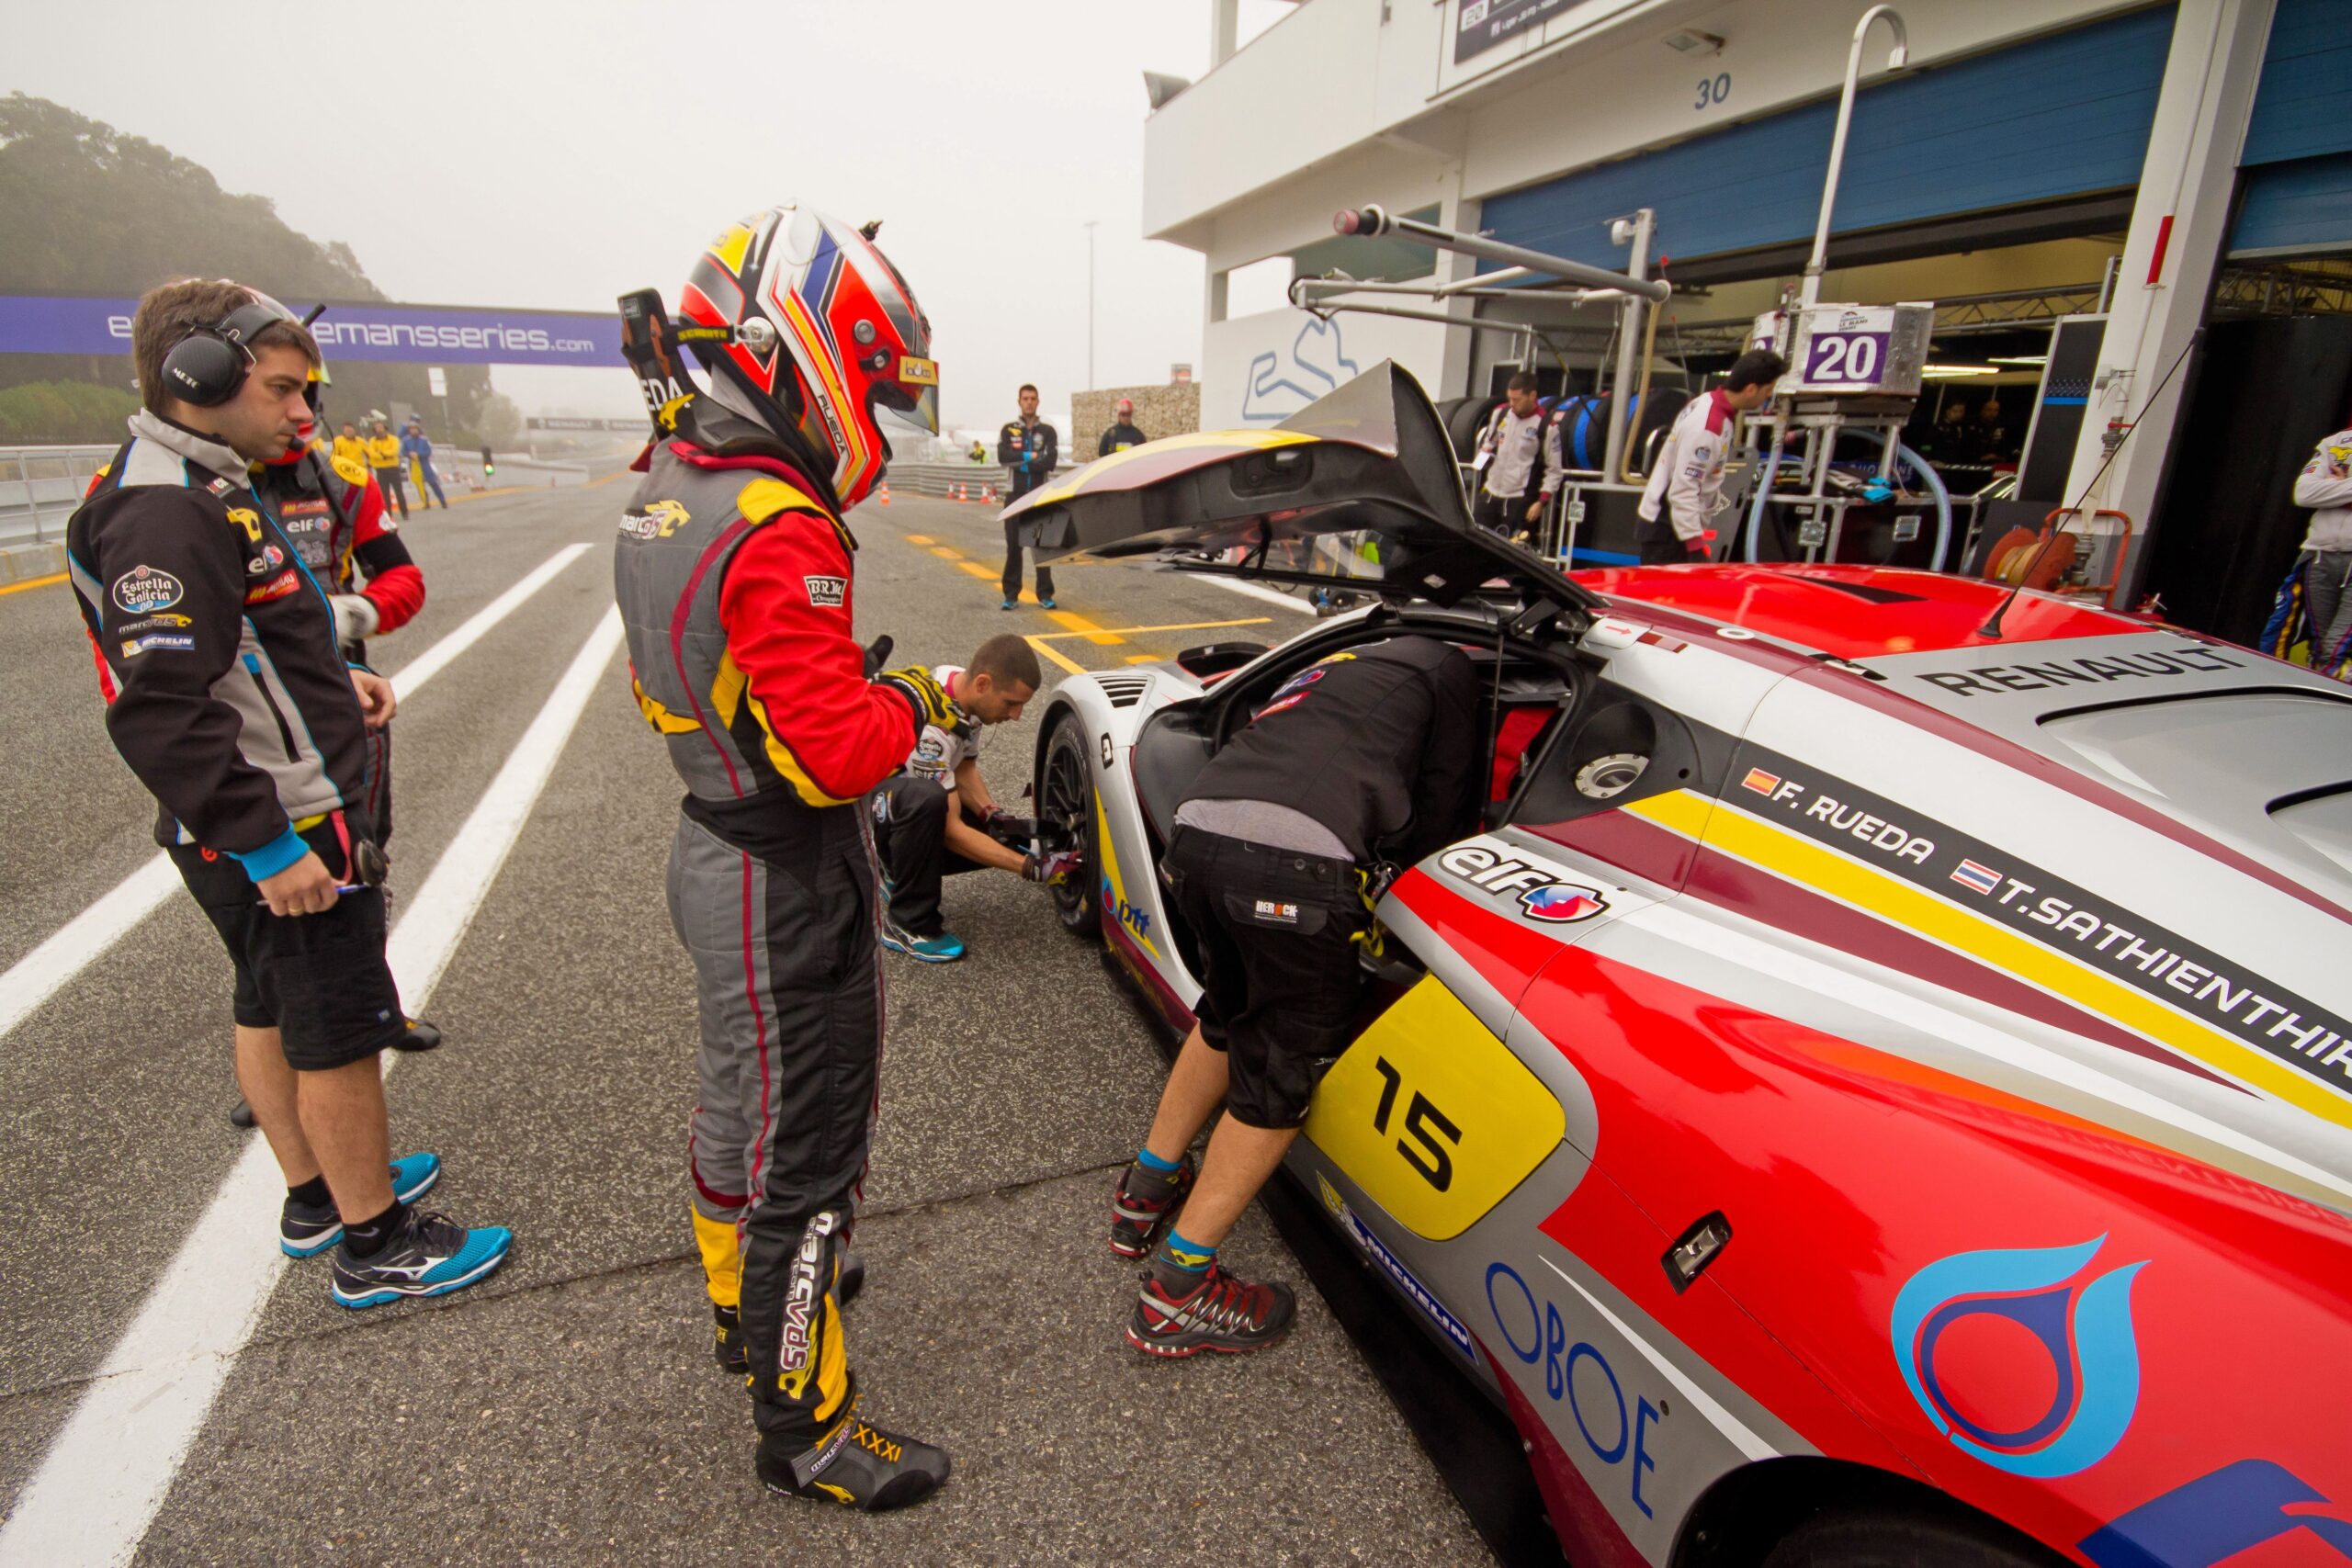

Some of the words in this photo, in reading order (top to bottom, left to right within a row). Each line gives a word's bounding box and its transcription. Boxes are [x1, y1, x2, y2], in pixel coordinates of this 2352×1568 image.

[1695, 72, 1731, 109] 30
[1812, 336, 1877, 380] 20
[640, 376, 691, 411] EDA
[818, 394, 847, 454] RUEDA
[287, 516, 313, 533] elf
[121, 578, 172, 594] Estrella
[125, 589, 171, 604] Galicia
[141, 637, 193, 648] MICHELIN
[1916, 646, 2247, 697] RENAULT
[1771, 780, 1805, 809] F.
[1805, 796, 1935, 865] RUEDA
[1440, 847, 1560, 894] elf
[1118, 899, 1150, 940] ptt
[1255, 900, 1298, 918] HEROCK
[1374, 1055, 1463, 1192] 15
[1367, 1235, 1469, 1346] MICHELIN
[1486, 1262, 1659, 1520] OBOE
